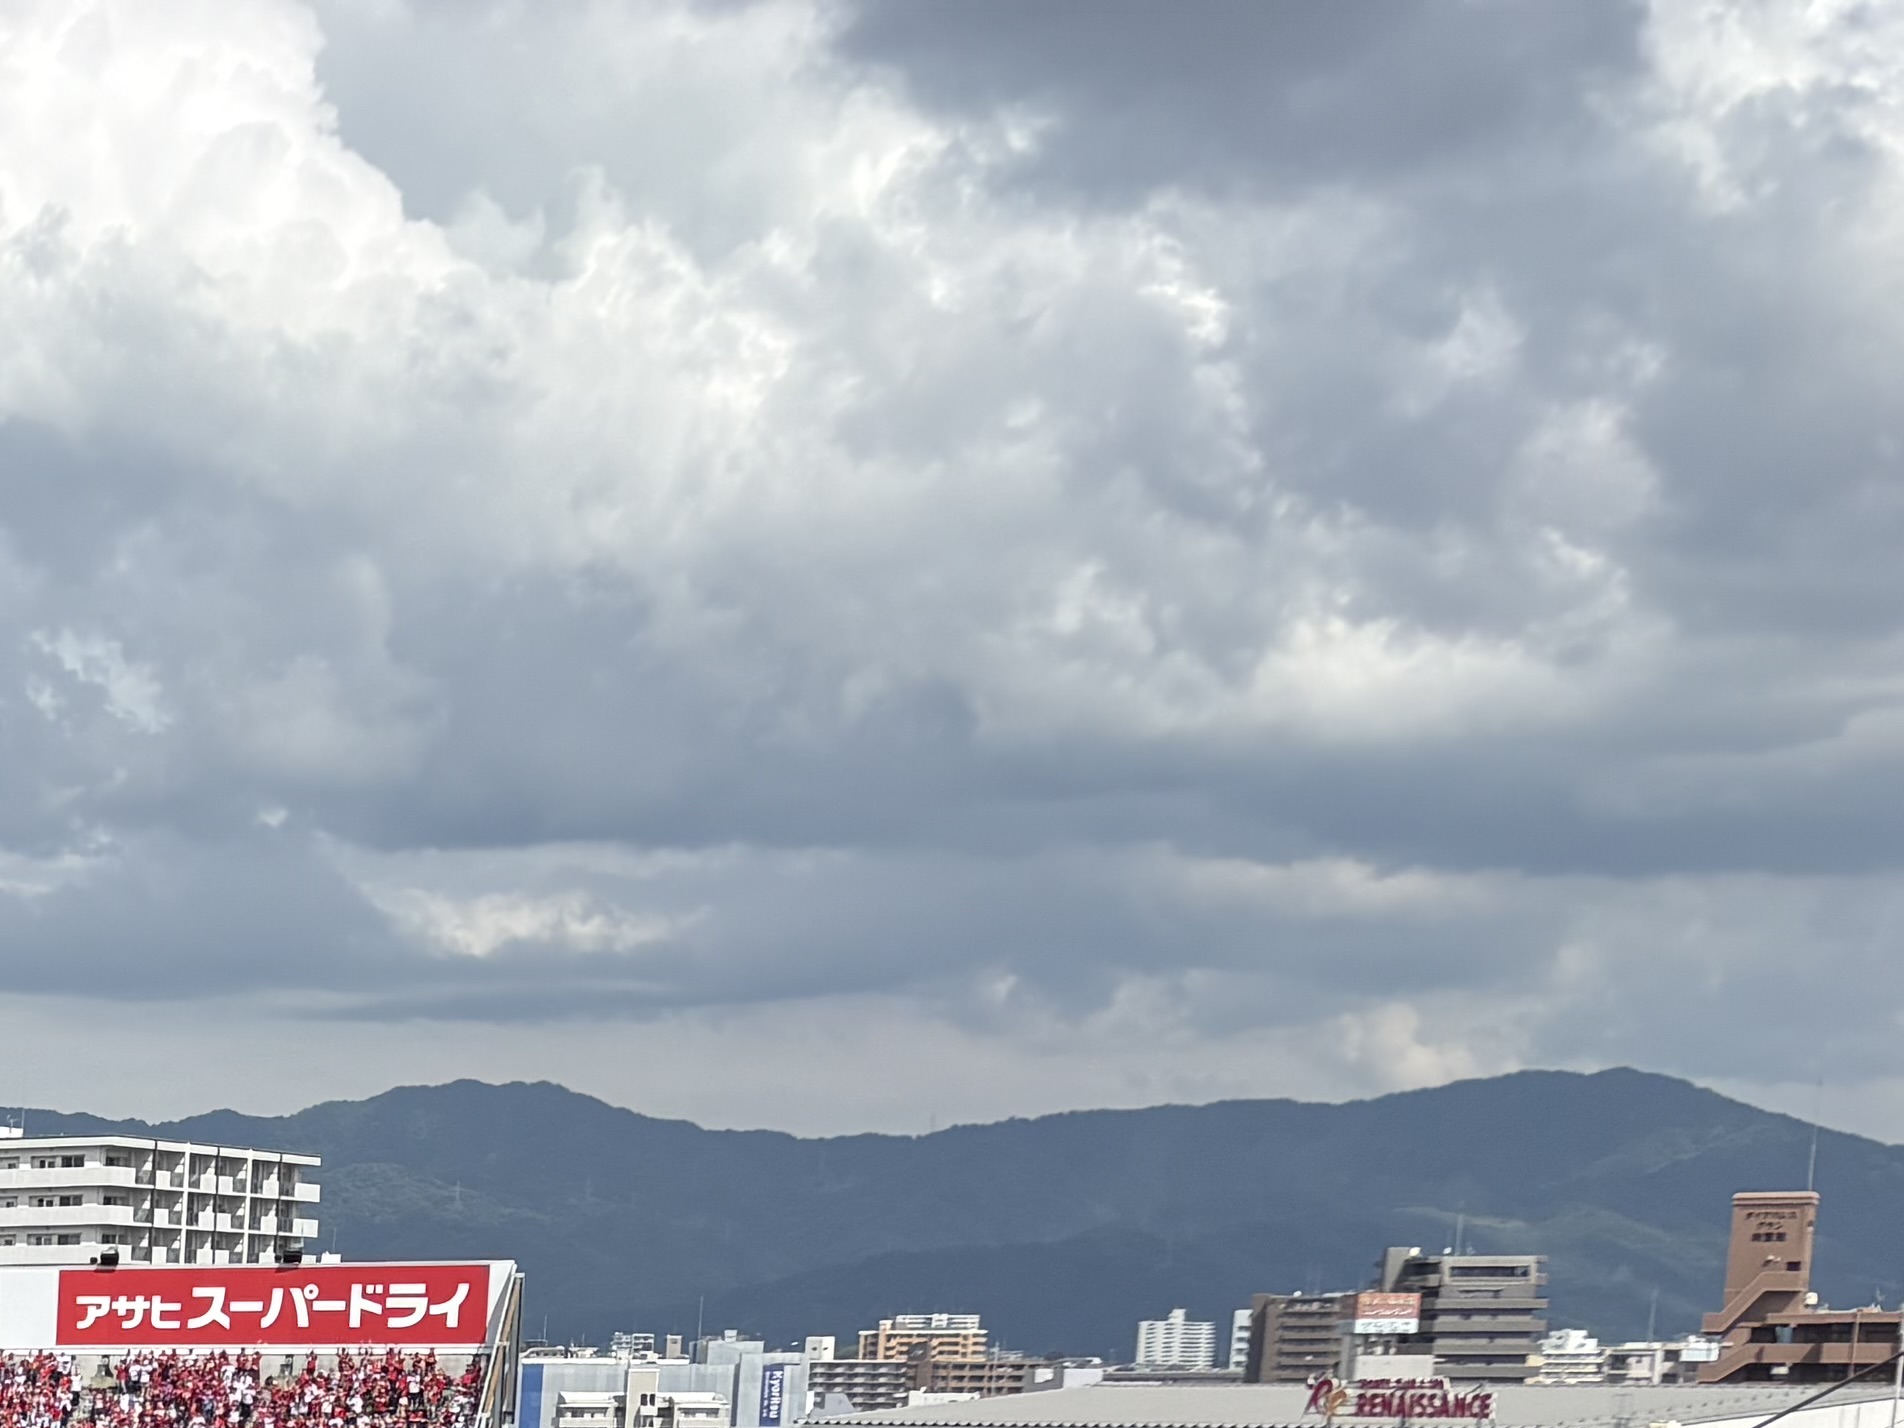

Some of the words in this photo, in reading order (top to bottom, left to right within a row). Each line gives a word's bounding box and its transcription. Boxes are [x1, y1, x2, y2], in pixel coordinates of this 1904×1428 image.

[75, 1295, 182, 1330] アサヒ
[187, 1282, 471, 1331] スーパードライ
